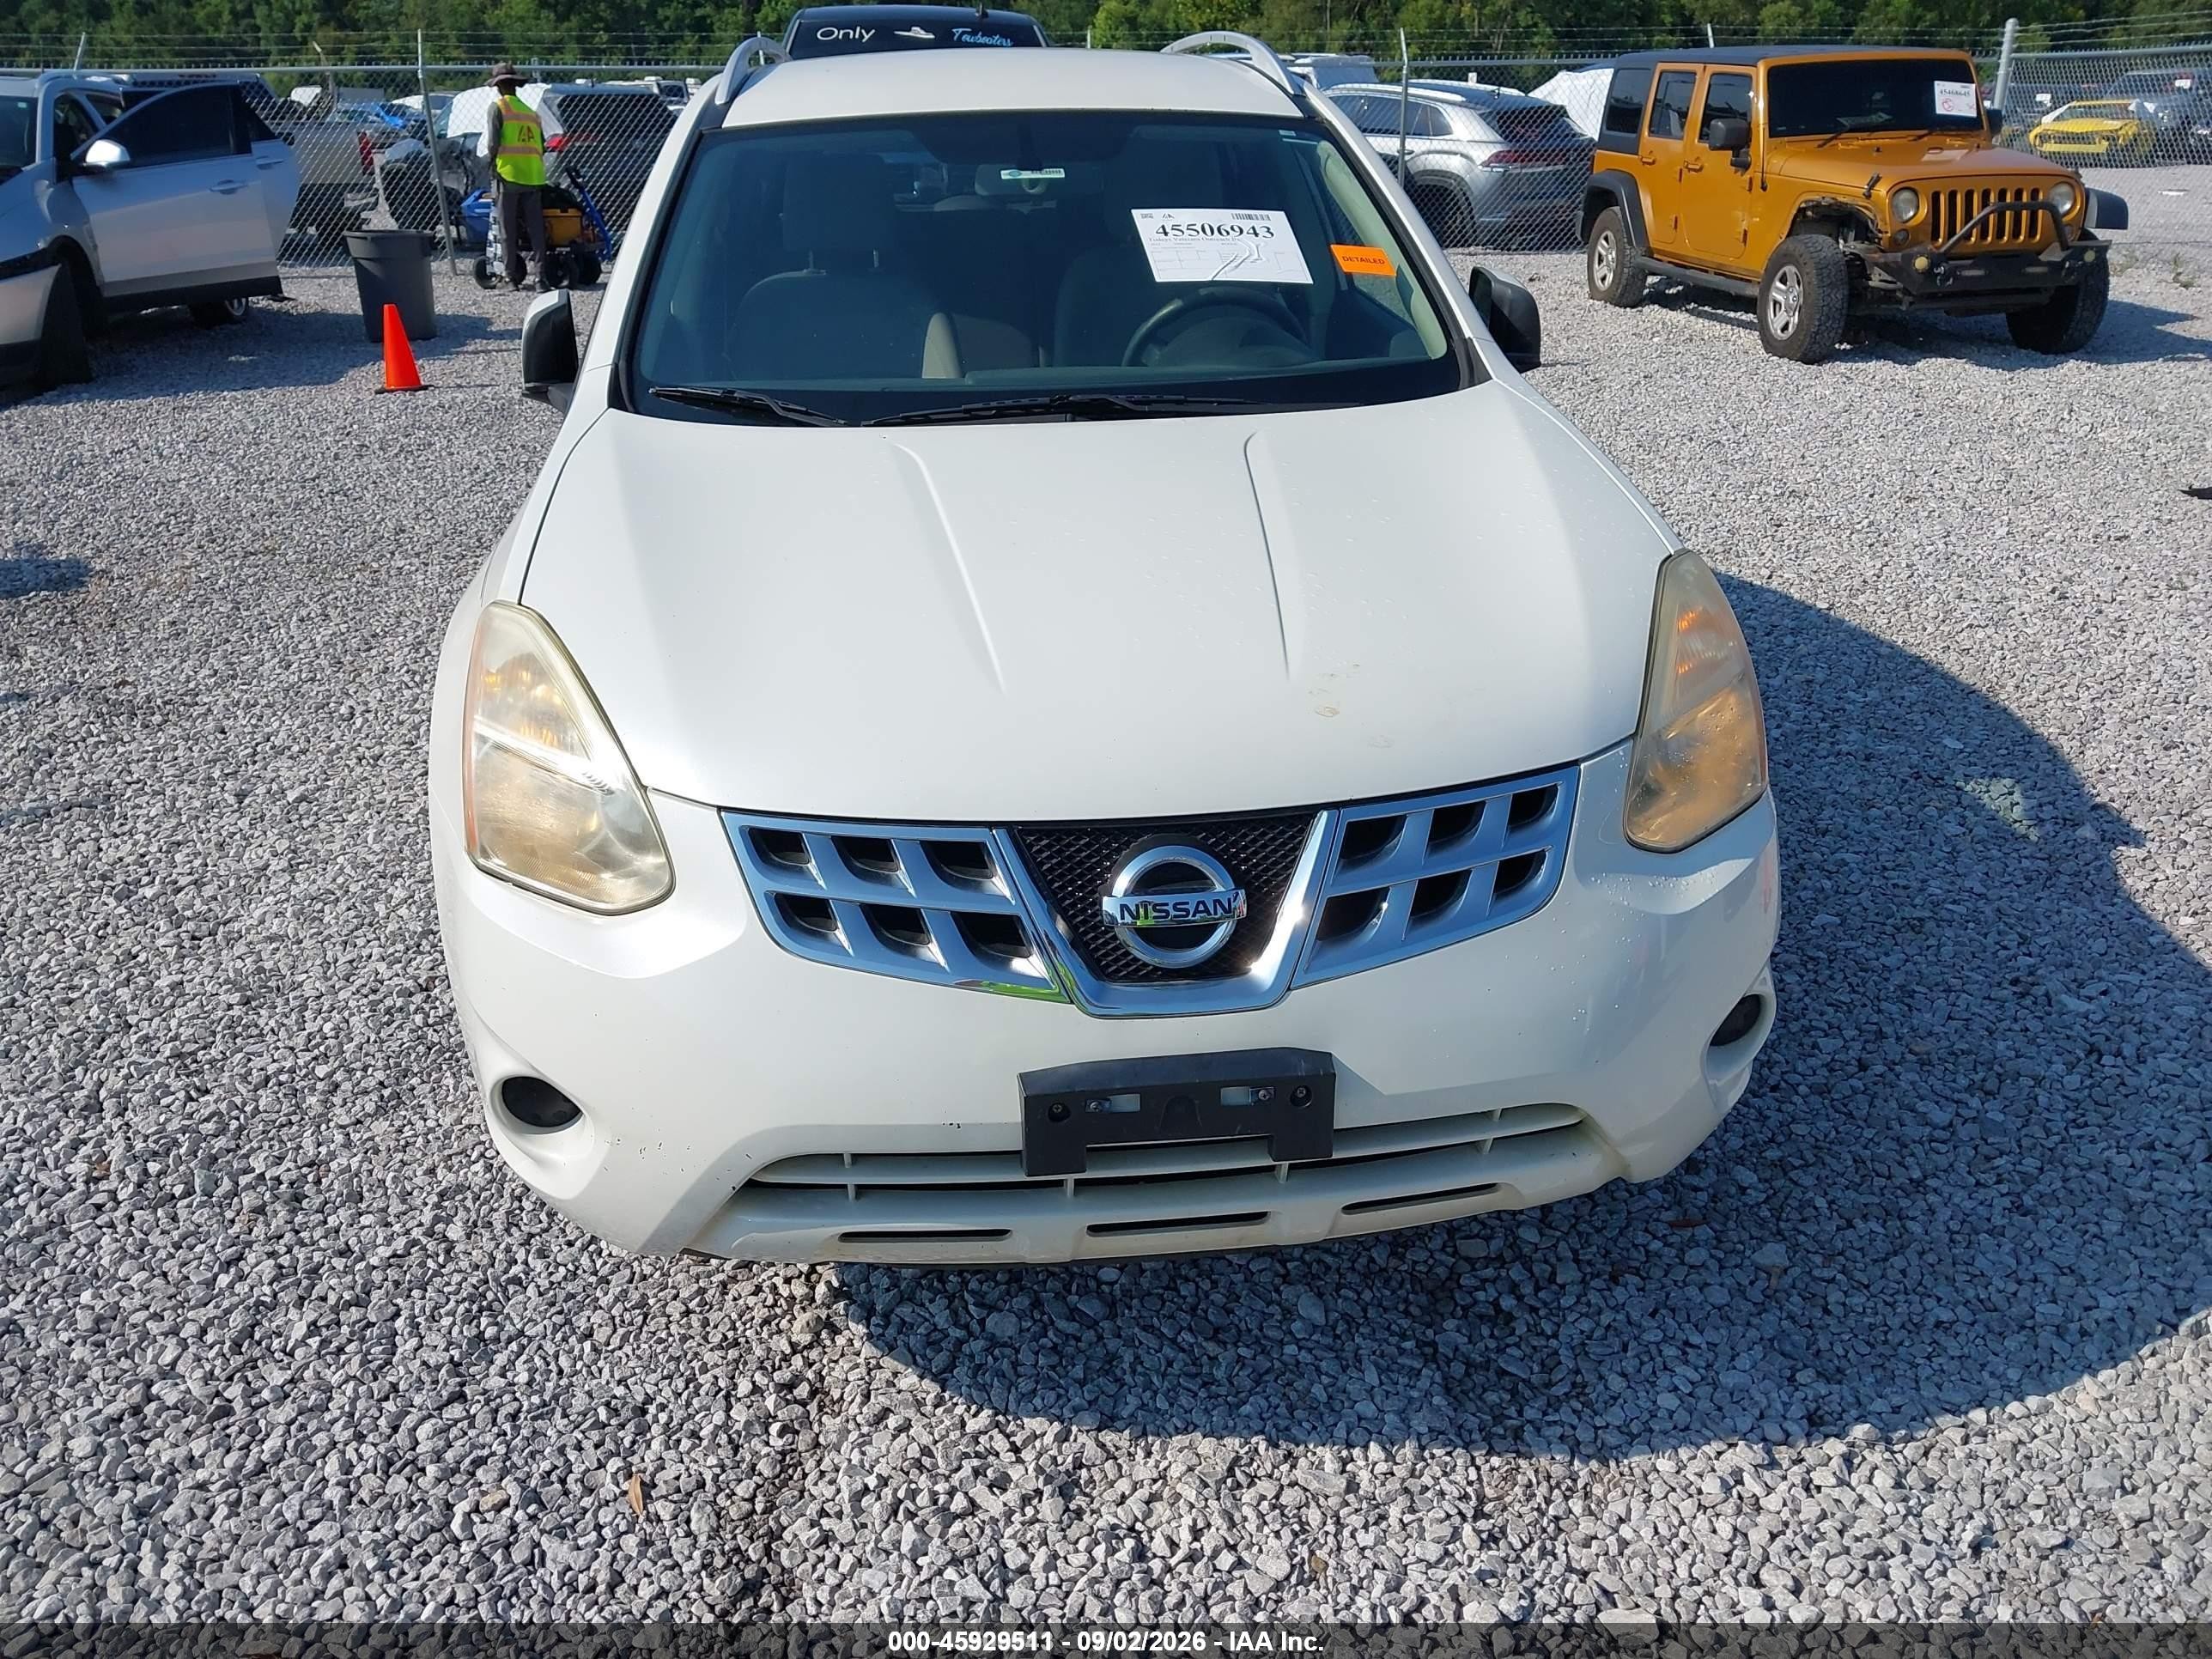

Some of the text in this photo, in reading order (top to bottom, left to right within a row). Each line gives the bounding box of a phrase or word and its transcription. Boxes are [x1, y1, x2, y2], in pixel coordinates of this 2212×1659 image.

[817, 26, 876, 43] Only
[1156, 222, 1274, 239] 45506943
[1342, 256, 1385, 264] DETAILED
[1119, 898, 1234, 921] NISSAN
